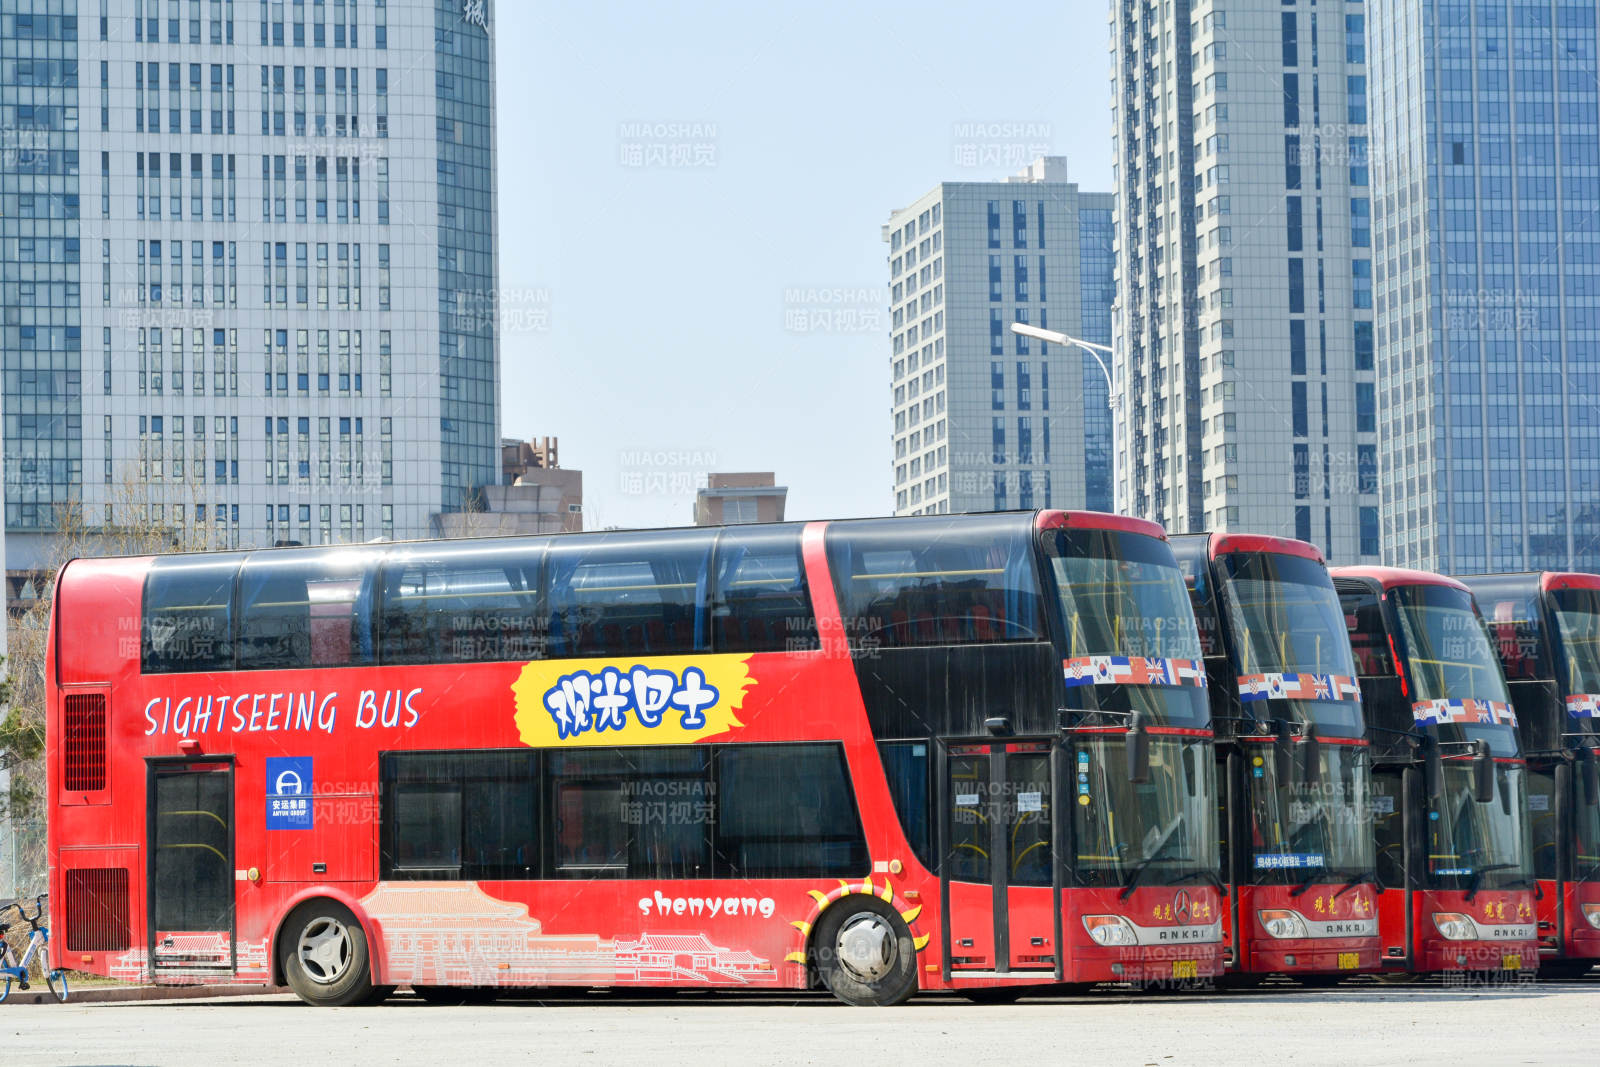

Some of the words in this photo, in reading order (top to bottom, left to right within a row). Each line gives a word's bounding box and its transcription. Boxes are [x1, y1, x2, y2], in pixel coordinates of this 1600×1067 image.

[544, 665, 718, 738] 观光巴士
[145, 691, 338, 737] SIGHTSEEING
[355, 688, 422, 728] BUS
[638, 890, 775, 918] shenyang
[1159, 929, 1205, 940] ANKAI
[1326, 924, 1365, 933] ANKAI
[1494, 929, 1527, 937] ANKAI
